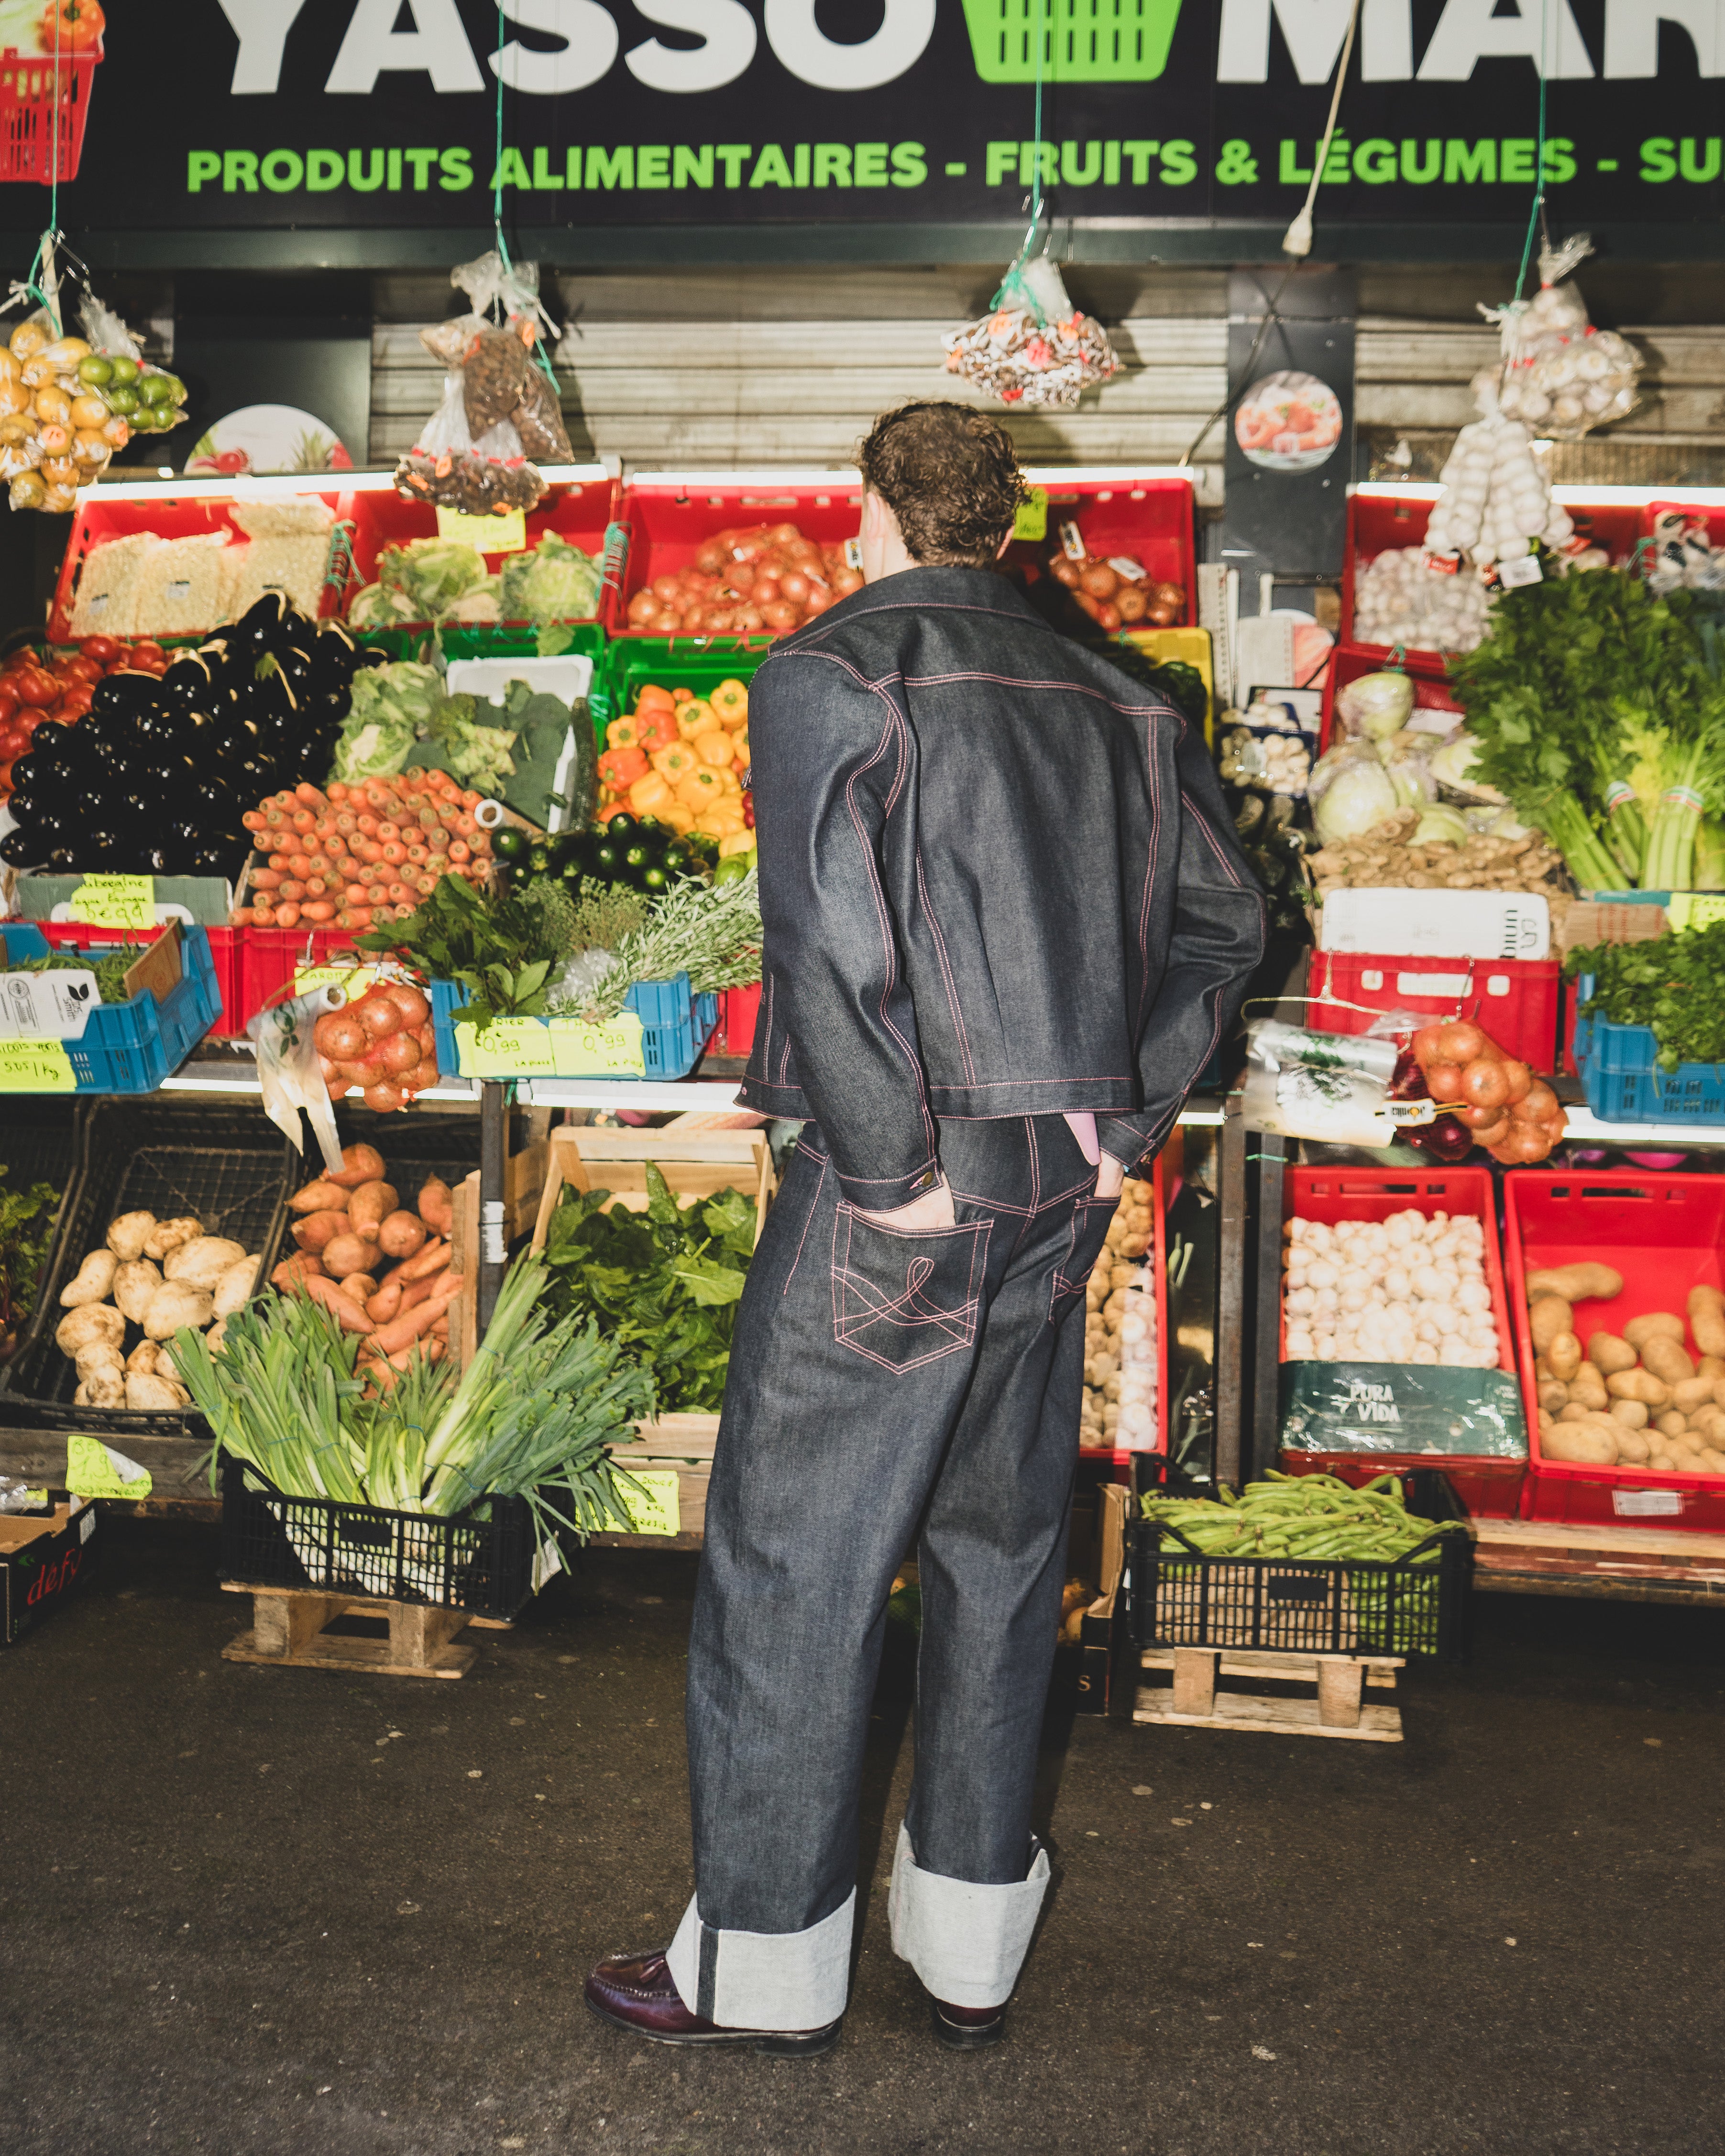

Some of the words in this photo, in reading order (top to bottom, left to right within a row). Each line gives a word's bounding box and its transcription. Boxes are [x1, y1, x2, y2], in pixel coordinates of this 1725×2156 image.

[187, 147, 474, 192] PRODUITS
[489, 141, 928, 190] ALIMENTAIRES
[985, 139, 1198, 186] FRUITS
[1215, 139, 1258, 185] &
[1278, 128, 1577, 185] LÉGUMES
[1350, 1384, 1395, 1402] PURA
[1357, 1404, 1400, 1422] VIDA
